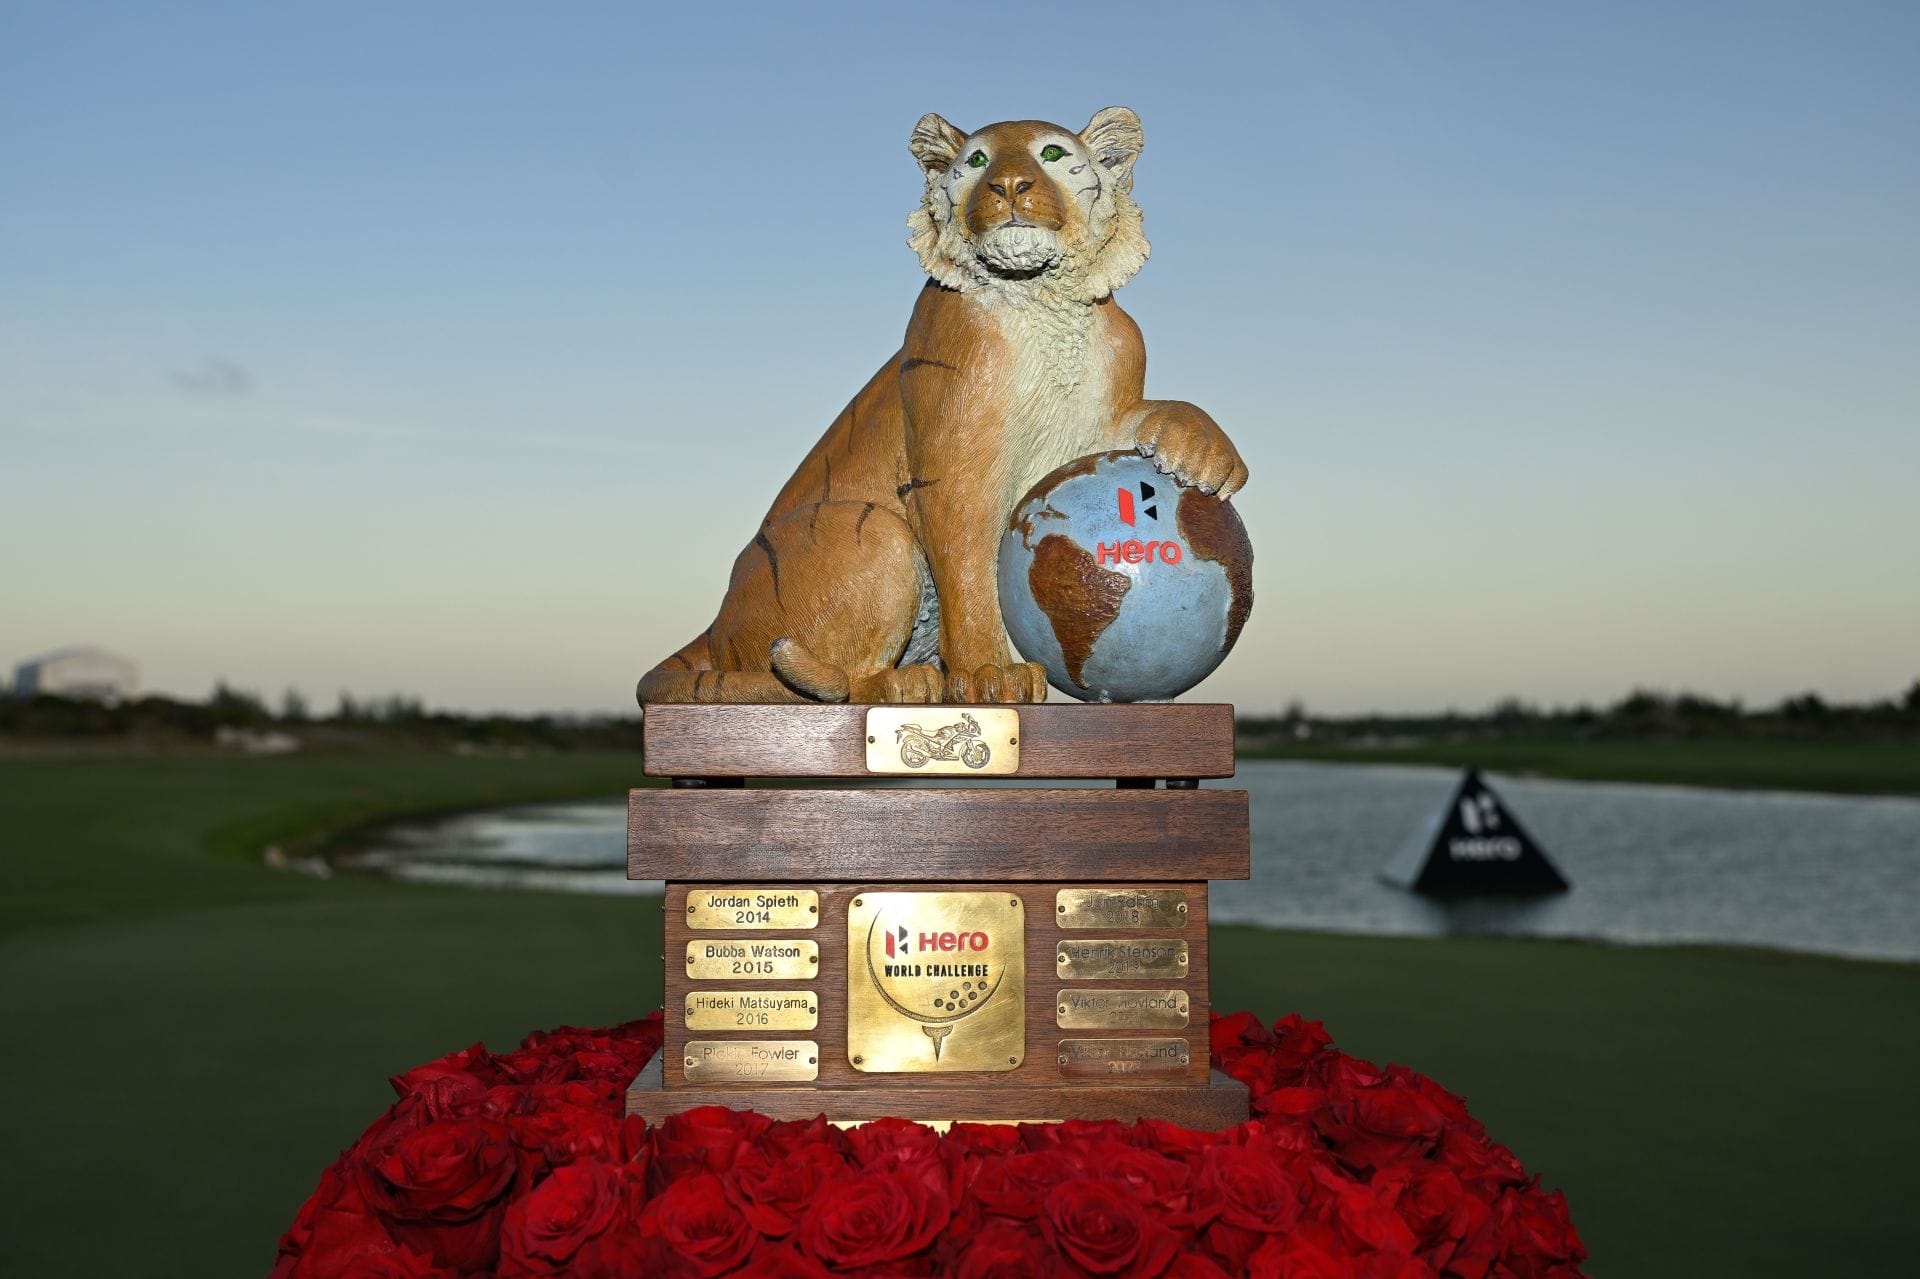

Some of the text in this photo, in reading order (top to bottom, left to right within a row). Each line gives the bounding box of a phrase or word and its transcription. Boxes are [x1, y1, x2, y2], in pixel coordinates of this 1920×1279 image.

[1096, 538, 1183, 566] Hero
[1448, 836, 1524, 862] Hero
[707, 895, 799, 911] Jordan Spieth
[735, 911, 771, 924] 2014
[918, 931, 990, 953] Hero
[705, 945, 801, 958] Bubba Watson
[1071, 945, 1176, 958] Henrik Stenson
[732, 961, 774, 974] 2015
[884, 964, 989, 977] WORLD CHALLENGE
[696, 997, 808, 1012] Hideki Matsuyama
[1071, 996, 1109, 1009] Viktor
[736, 1012, 769, 1025] 2016
[751, 1046, 800, 1060] Fowler
[735, 1062, 769, 1076] 2017
